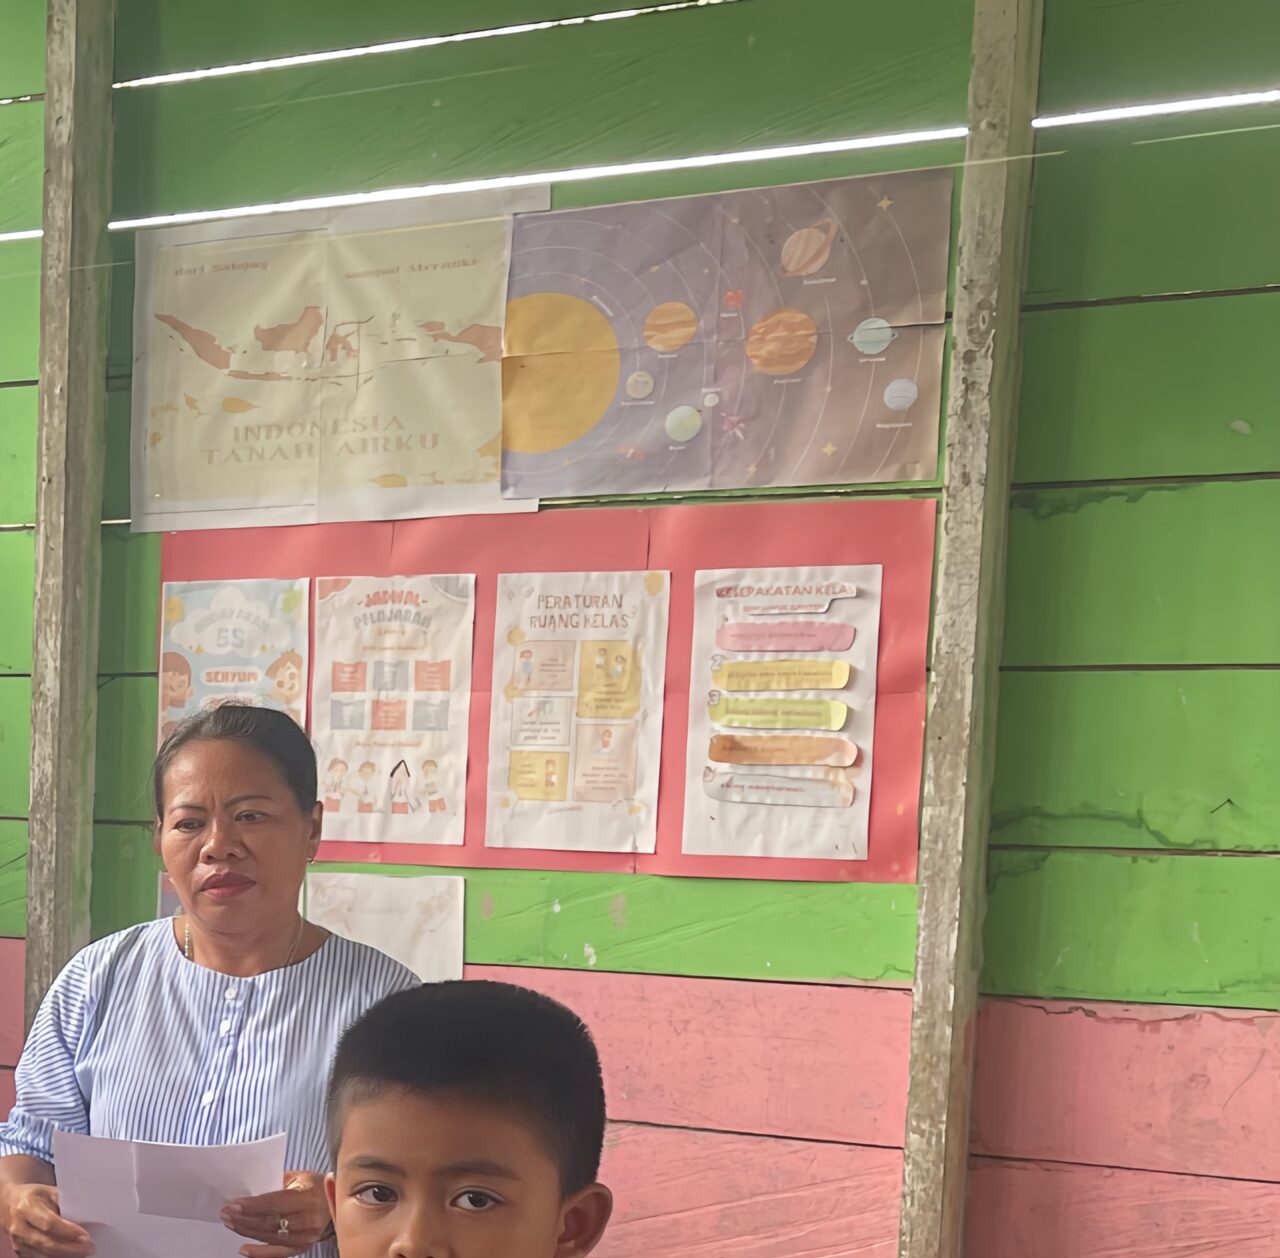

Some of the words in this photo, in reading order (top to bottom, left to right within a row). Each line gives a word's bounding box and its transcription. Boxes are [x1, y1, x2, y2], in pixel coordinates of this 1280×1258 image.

[233, 415, 405, 442] INDONESIA
[205, 442, 314, 465] TANAH
[336, 432, 439, 457] AIRKU
[537, 593, 624, 610] PERATURAN
[529, 613, 580, 629] RUANG
[583, 613, 630, 629] KELAS
